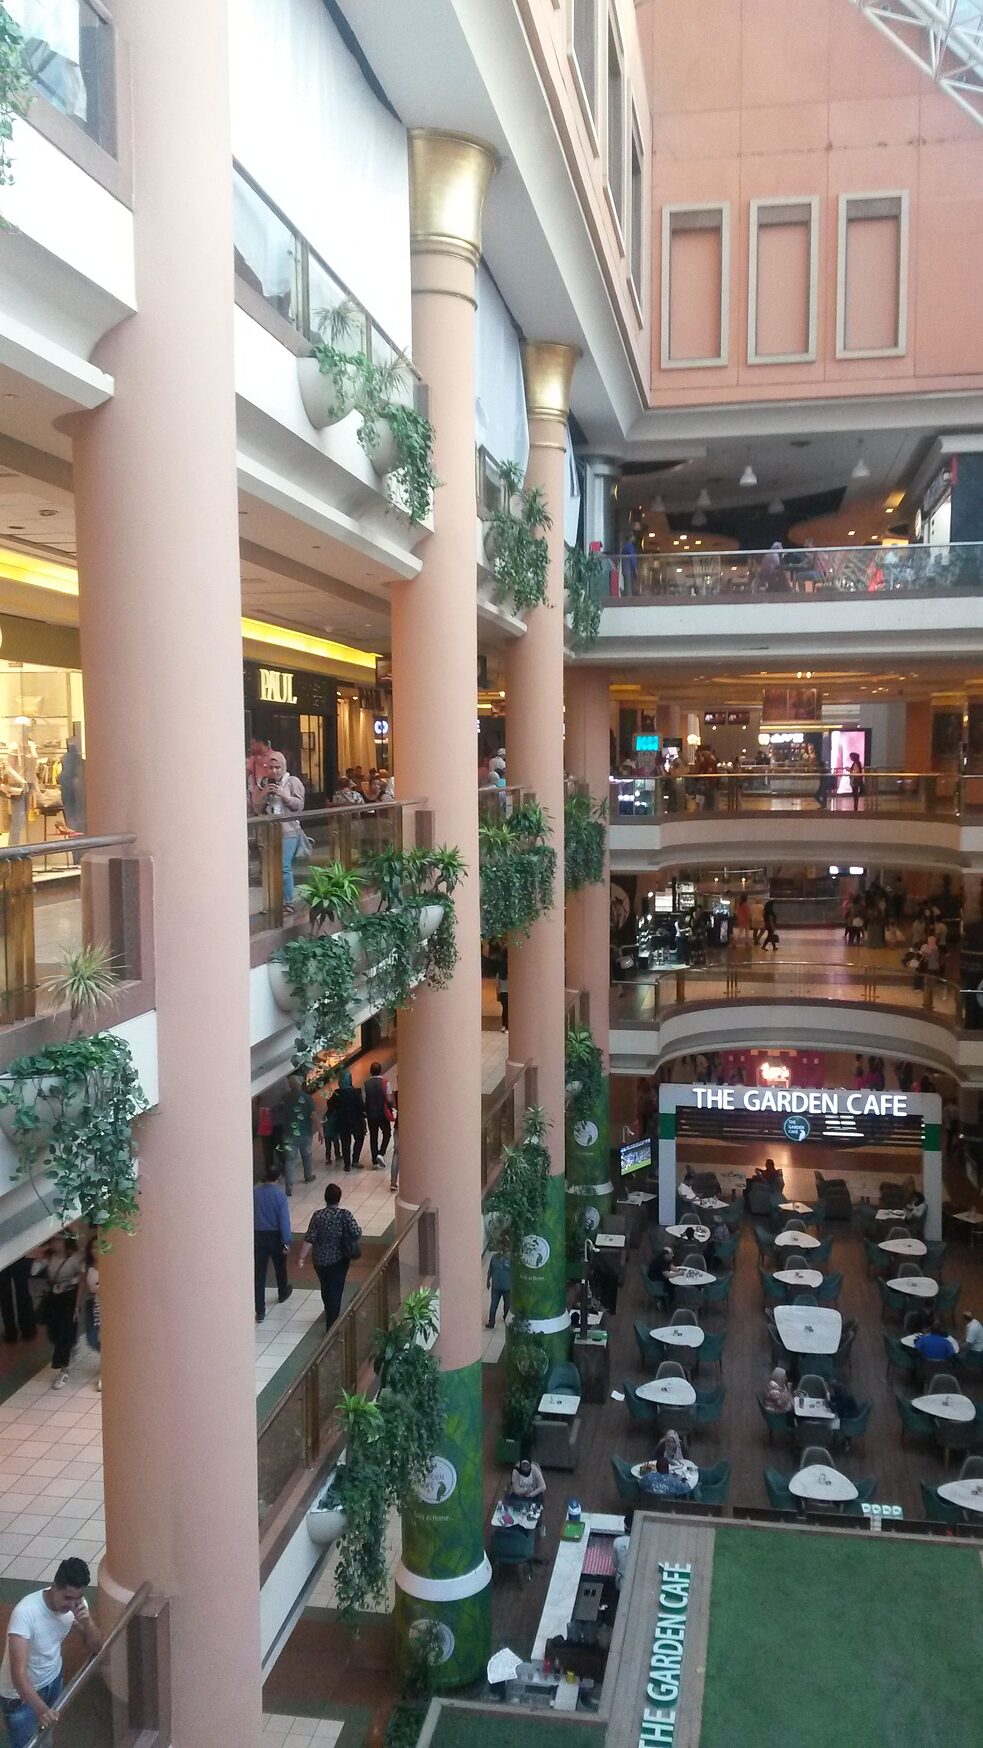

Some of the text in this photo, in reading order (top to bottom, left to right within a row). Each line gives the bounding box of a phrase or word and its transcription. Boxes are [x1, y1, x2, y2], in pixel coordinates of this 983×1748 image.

[259, 668, 298, 705] PAUL
[692, 1087, 908, 1117] THE GARDEN CAFE
[646, 1613, 687, 1703] GARDEN
